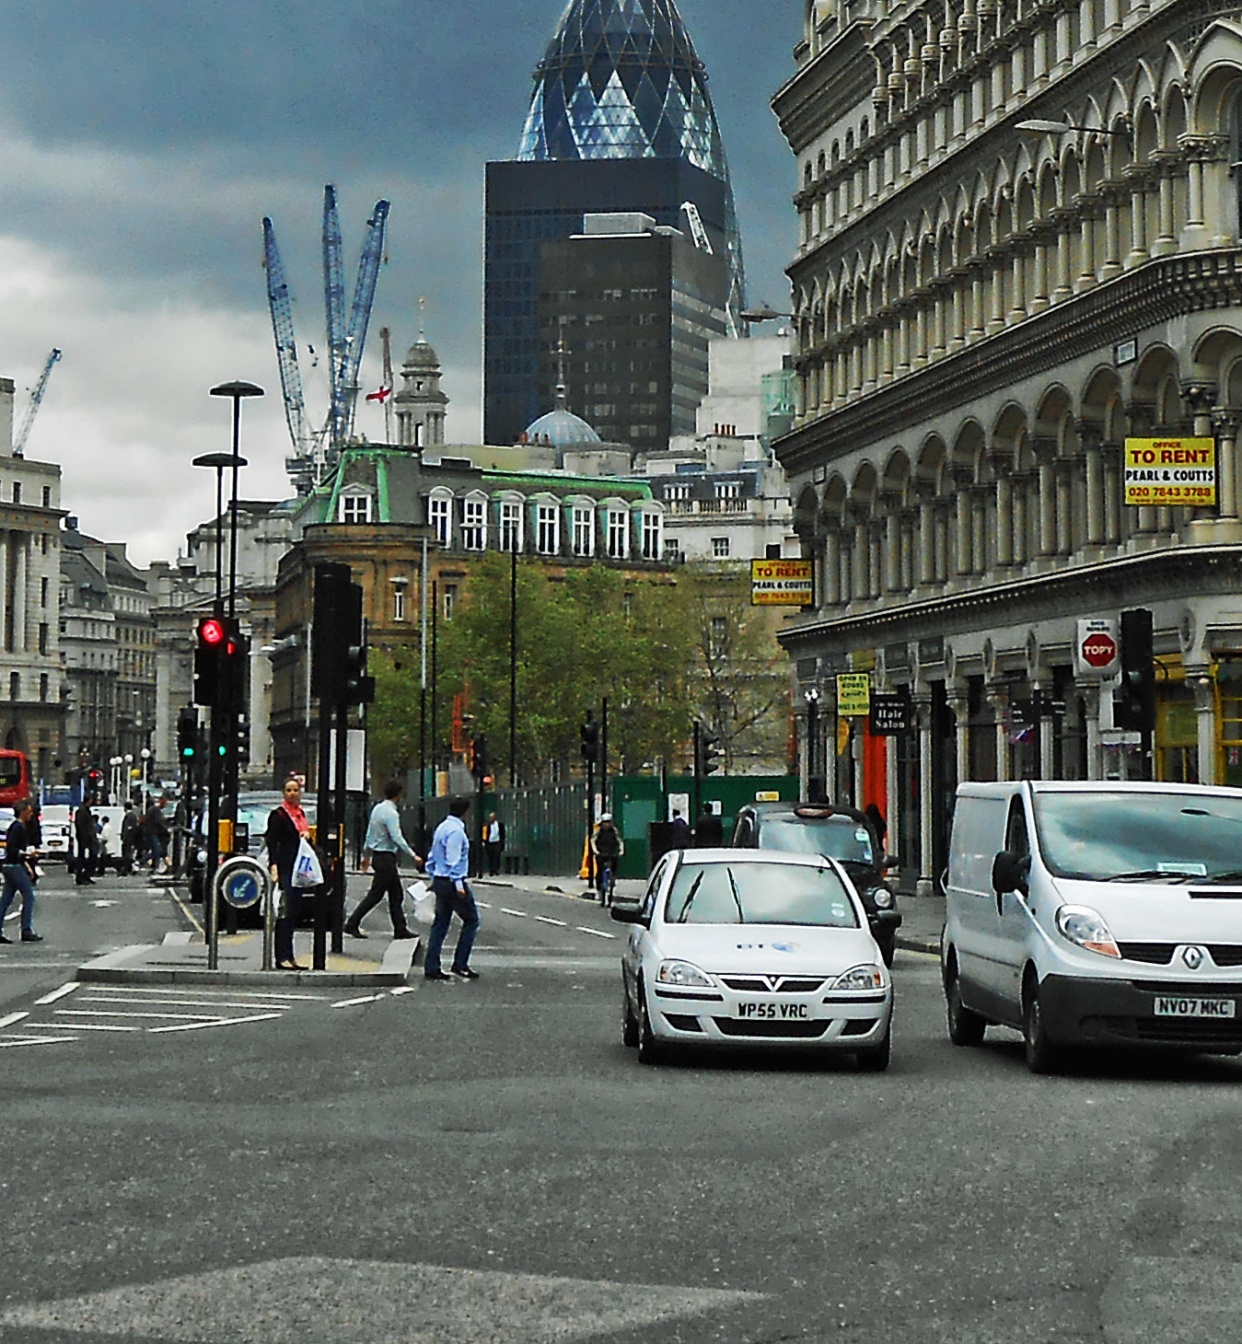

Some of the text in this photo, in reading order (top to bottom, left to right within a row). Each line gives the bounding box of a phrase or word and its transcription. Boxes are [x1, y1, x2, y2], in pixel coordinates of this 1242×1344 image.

[1130, 450, 1209, 463] TO RENT
[1126, 470, 1213, 481] PEARL & COUTTS
[1129, 487, 1211, 496] 020 7843 3788
[756, 568, 808, 576] TO RENT
[1084, 646, 1113, 655] TOPY
[878, 710, 902, 718] Hair
[875, 720, 905, 729] Salon
[738, 1003, 807, 1018] WP55 VRC
[1160, 999, 1229, 1015] NV07 MKC
